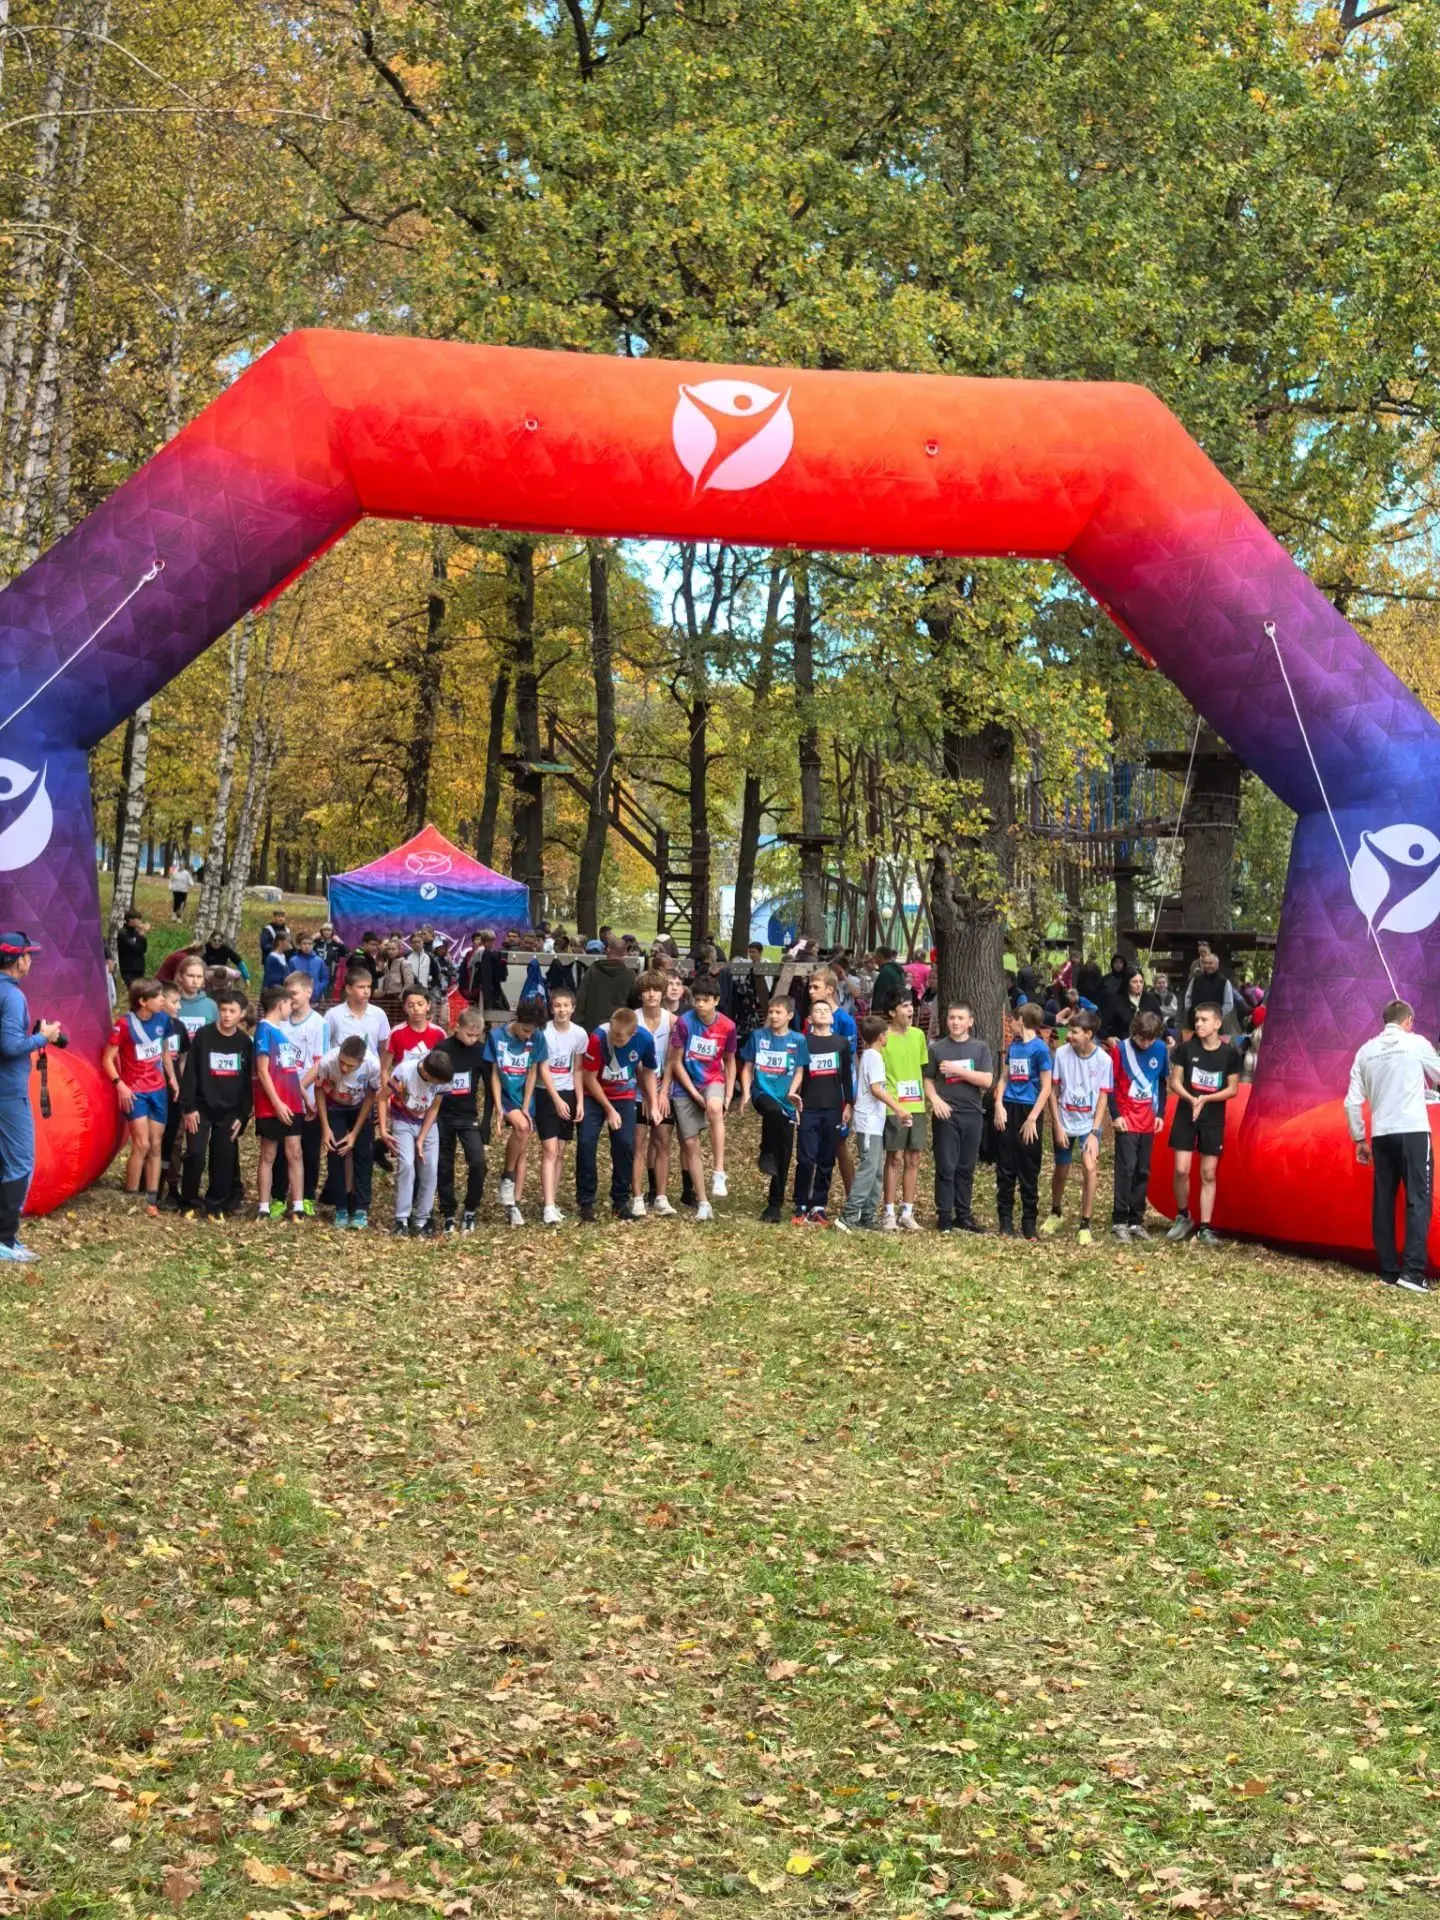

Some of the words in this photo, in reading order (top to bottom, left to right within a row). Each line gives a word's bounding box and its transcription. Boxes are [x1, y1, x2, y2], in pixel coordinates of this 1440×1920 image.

[697, 1043, 712, 1054] 965
[218, 1060, 233, 1069] 279
[766, 1056, 783, 1067] 287
[816, 1059, 833, 1068] 270
